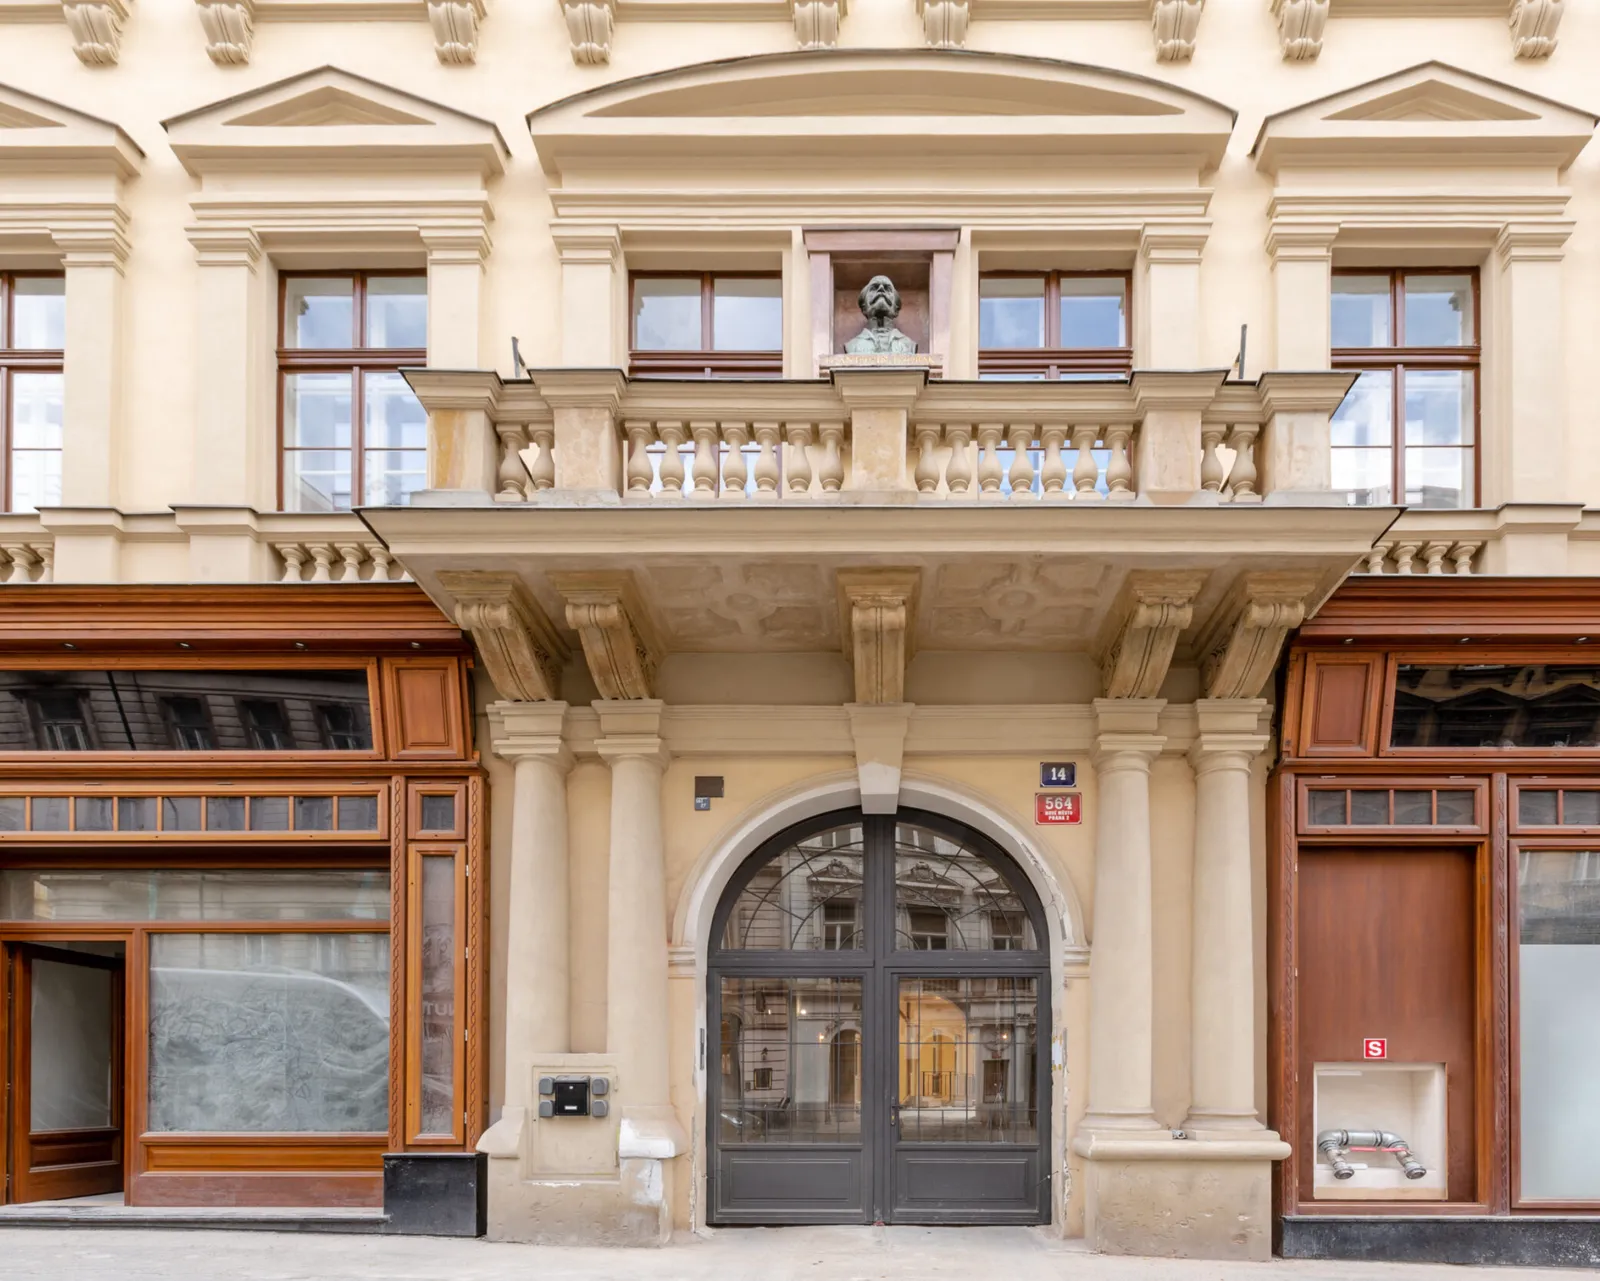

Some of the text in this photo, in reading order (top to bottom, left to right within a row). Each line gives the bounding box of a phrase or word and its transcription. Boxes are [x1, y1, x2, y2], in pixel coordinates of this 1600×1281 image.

[1051, 767, 1066, 781] 14
[1045, 796, 1072, 810] 564
[1368, 1041, 1382, 1056] S
